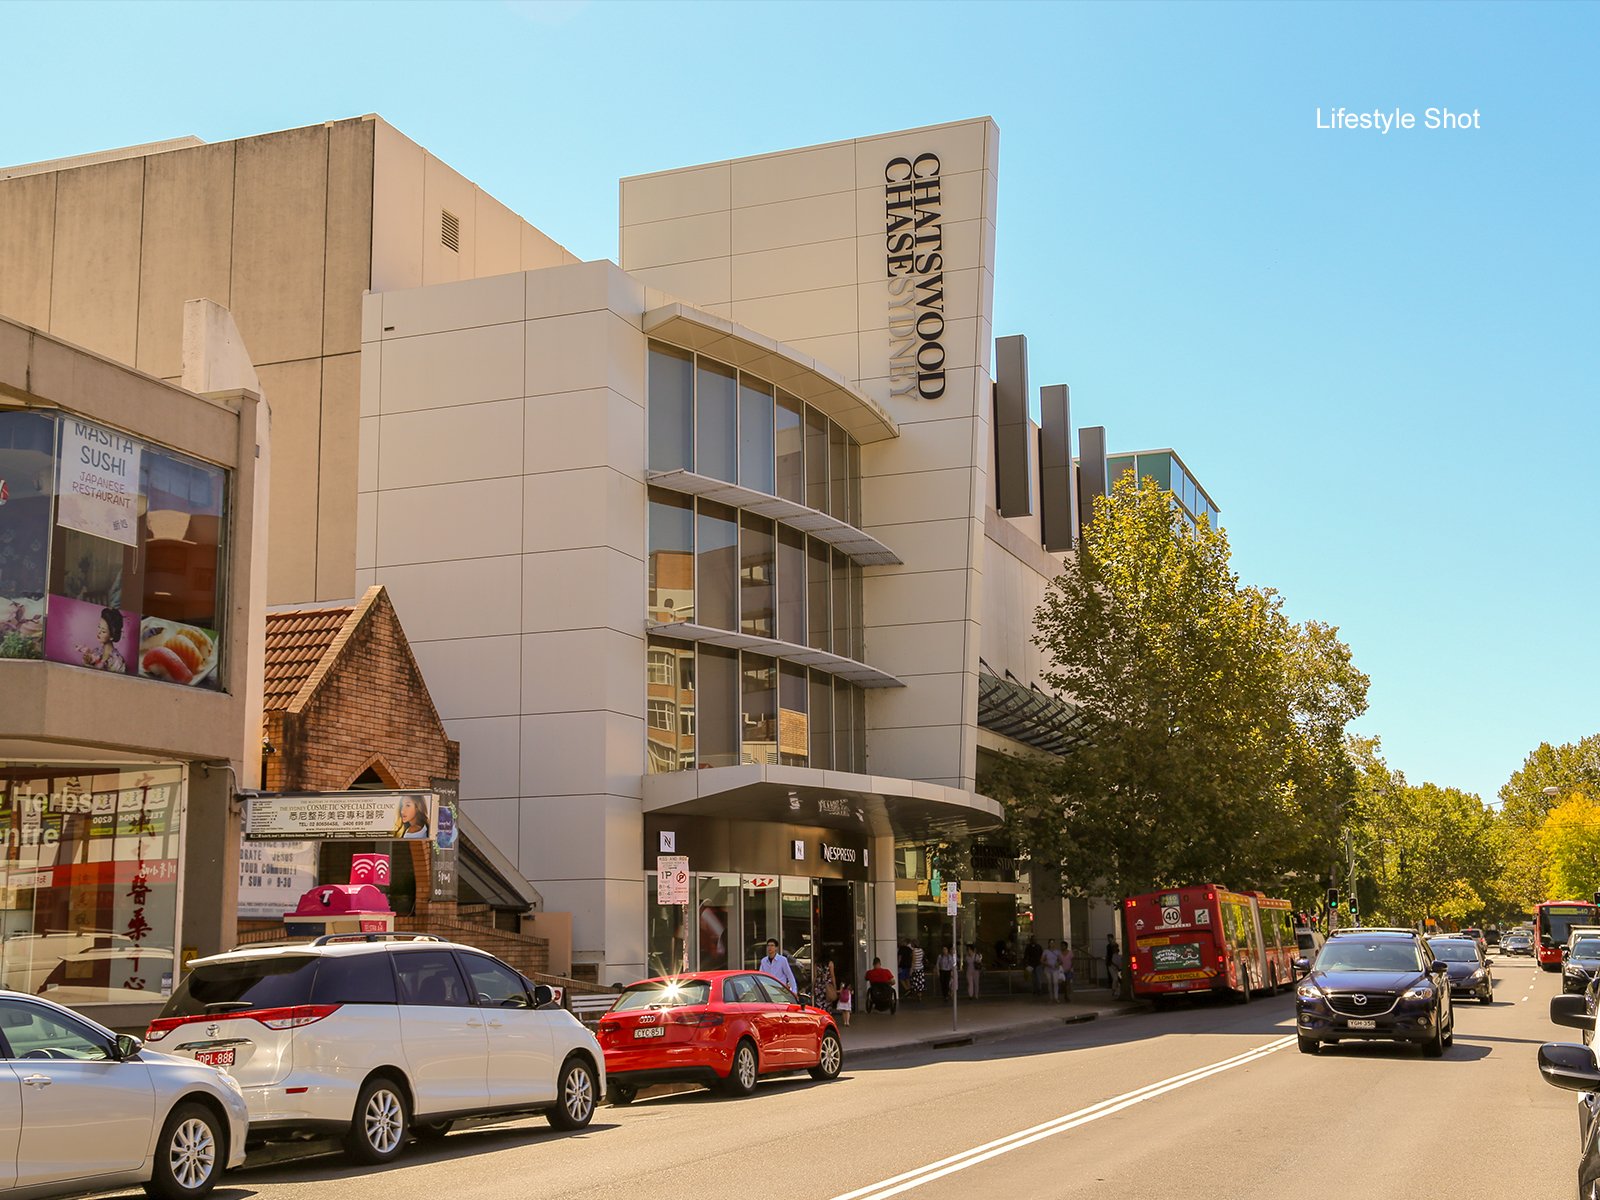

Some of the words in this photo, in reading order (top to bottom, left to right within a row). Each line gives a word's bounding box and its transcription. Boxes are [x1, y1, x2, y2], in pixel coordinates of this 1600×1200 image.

[884, 156, 915, 277] CHASE
[913, 152, 946, 400] CHATSWOOD
[887, 277, 918, 401] SYDNEY
[80, 445, 126, 477] SUSHI
[72, 481, 131, 509] RESTAURANT
[80, 471, 125, 495] JAPANESE
[12, 786, 92, 813] Herbs
[340, 802, 376, 810] SPECIALIST
[240, 862, 258, 874] YOUR
[248, 876, 262, 887] SUN
[1165, 911, 1179, 921] 40
